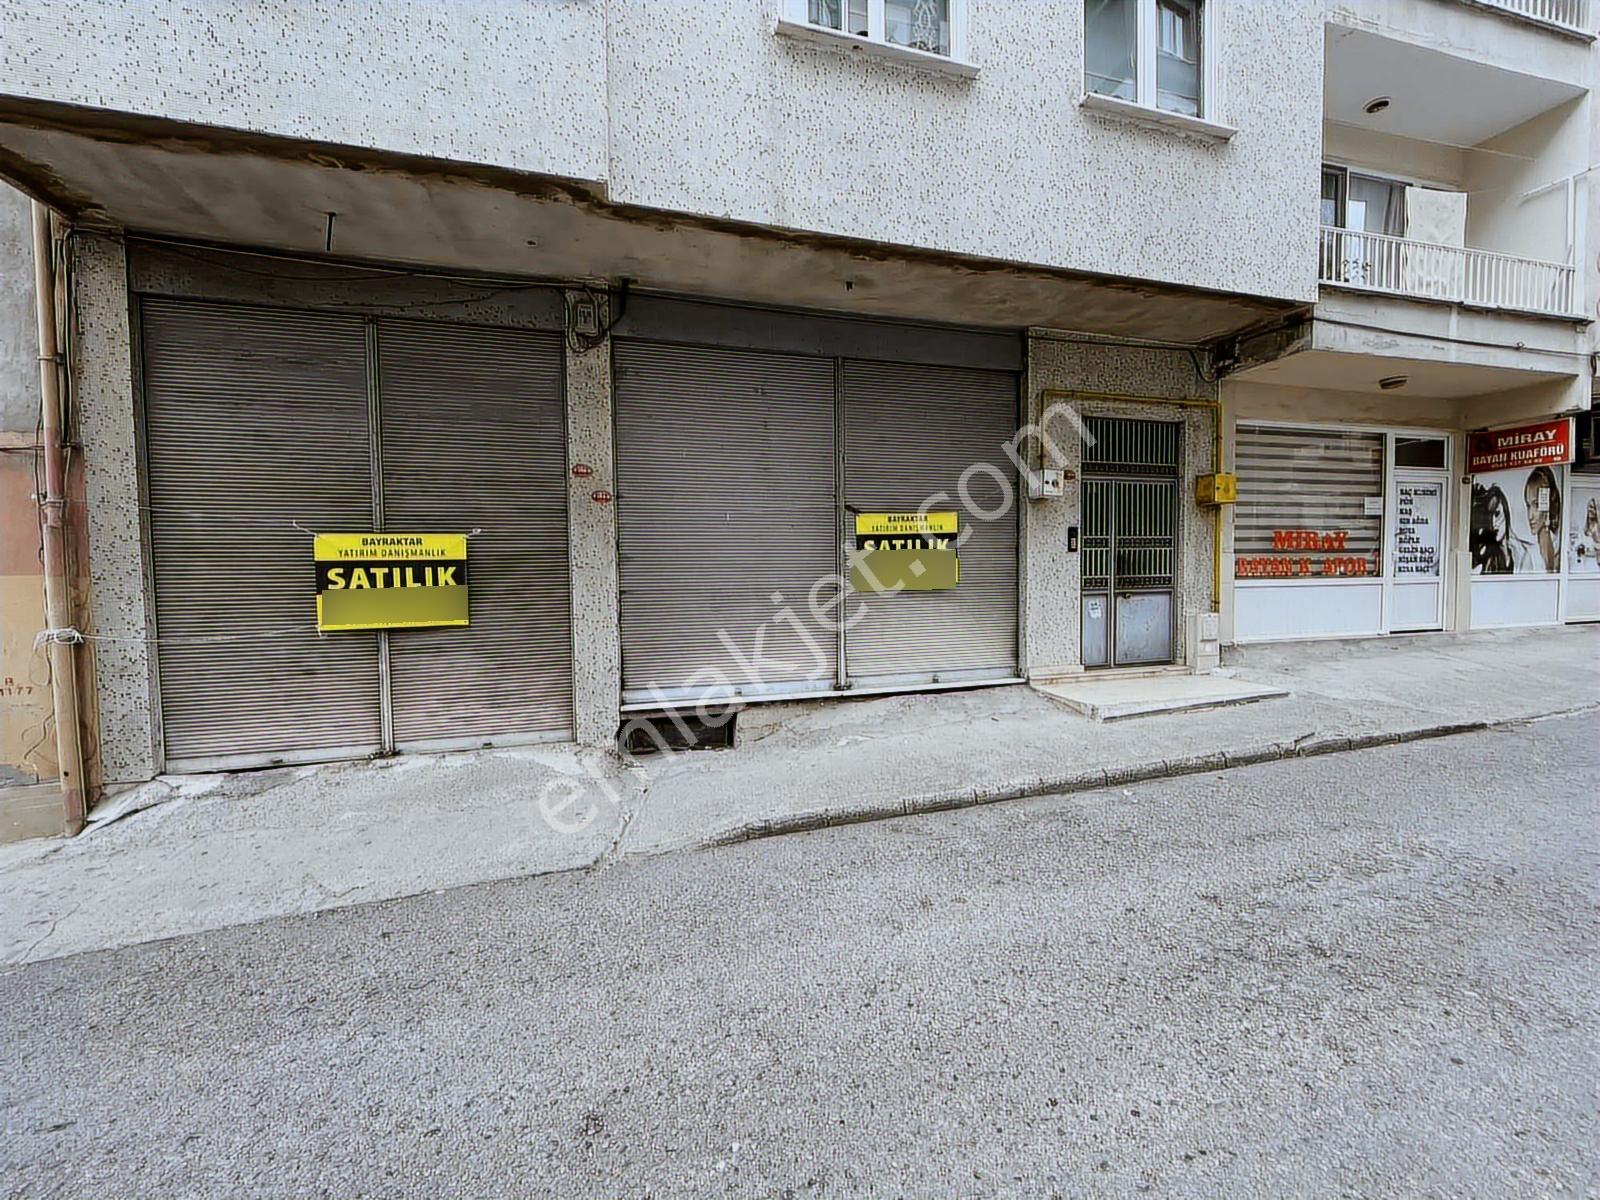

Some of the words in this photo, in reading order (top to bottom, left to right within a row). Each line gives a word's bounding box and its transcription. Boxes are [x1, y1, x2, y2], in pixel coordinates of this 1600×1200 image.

[1473, 453, 1507, 466] BAYAN
[362, 537, 423, 546] BAYRAKTAR
[337, 549, 377, 559] YATIRIM
[381, 548, 447, 559] DANIŞMANLIK
[326, 566, 458, 590] SATILIK
